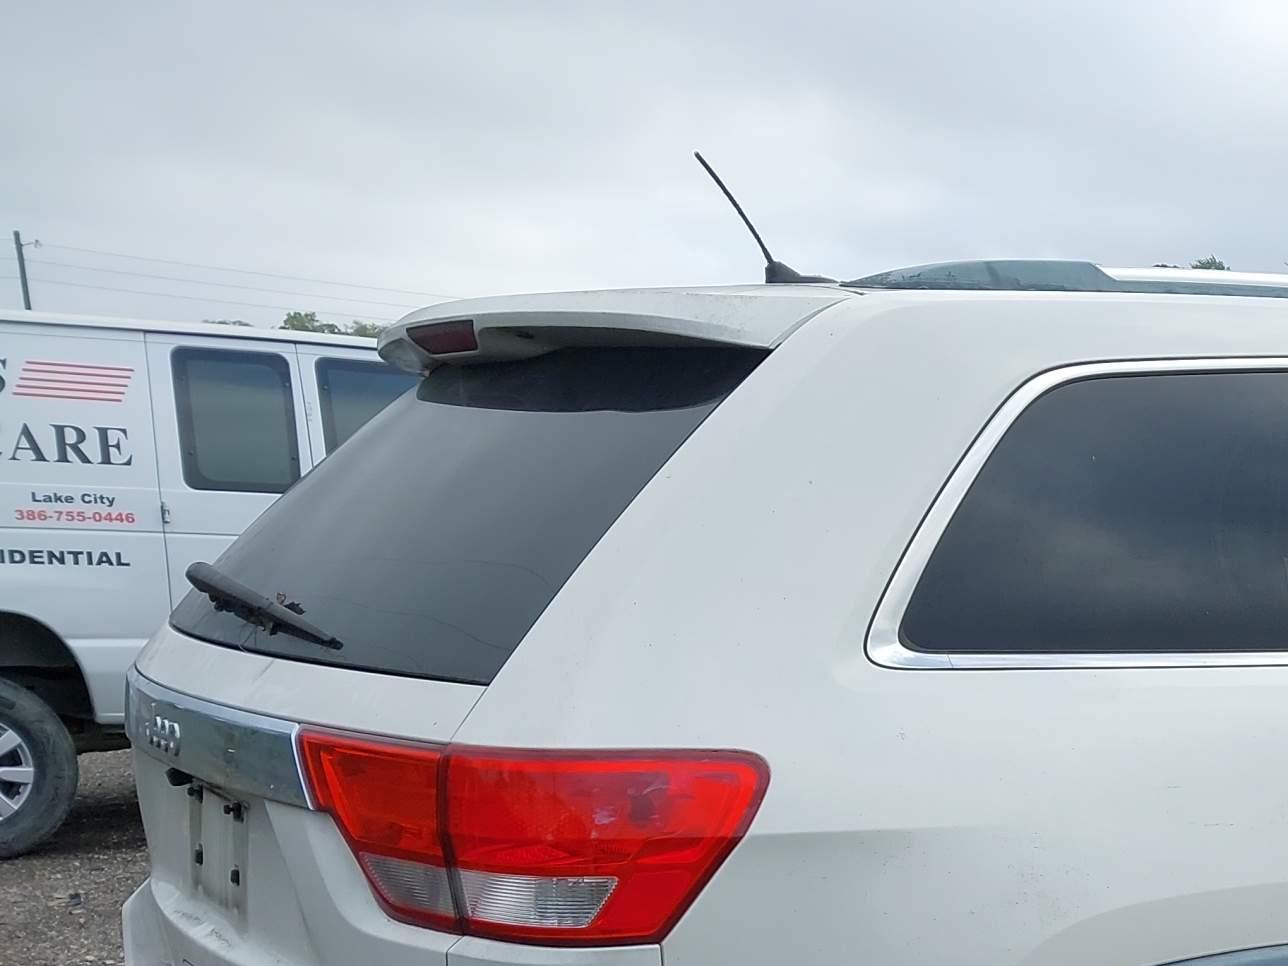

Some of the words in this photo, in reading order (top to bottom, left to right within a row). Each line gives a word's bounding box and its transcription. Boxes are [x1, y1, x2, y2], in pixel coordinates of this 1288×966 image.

[0, 422, 133, 466] ARE
[31, 491, 75, 504] Lake
[80, 493, 116, 508] City
[14, 509, 136, 524] 386-755-0446
